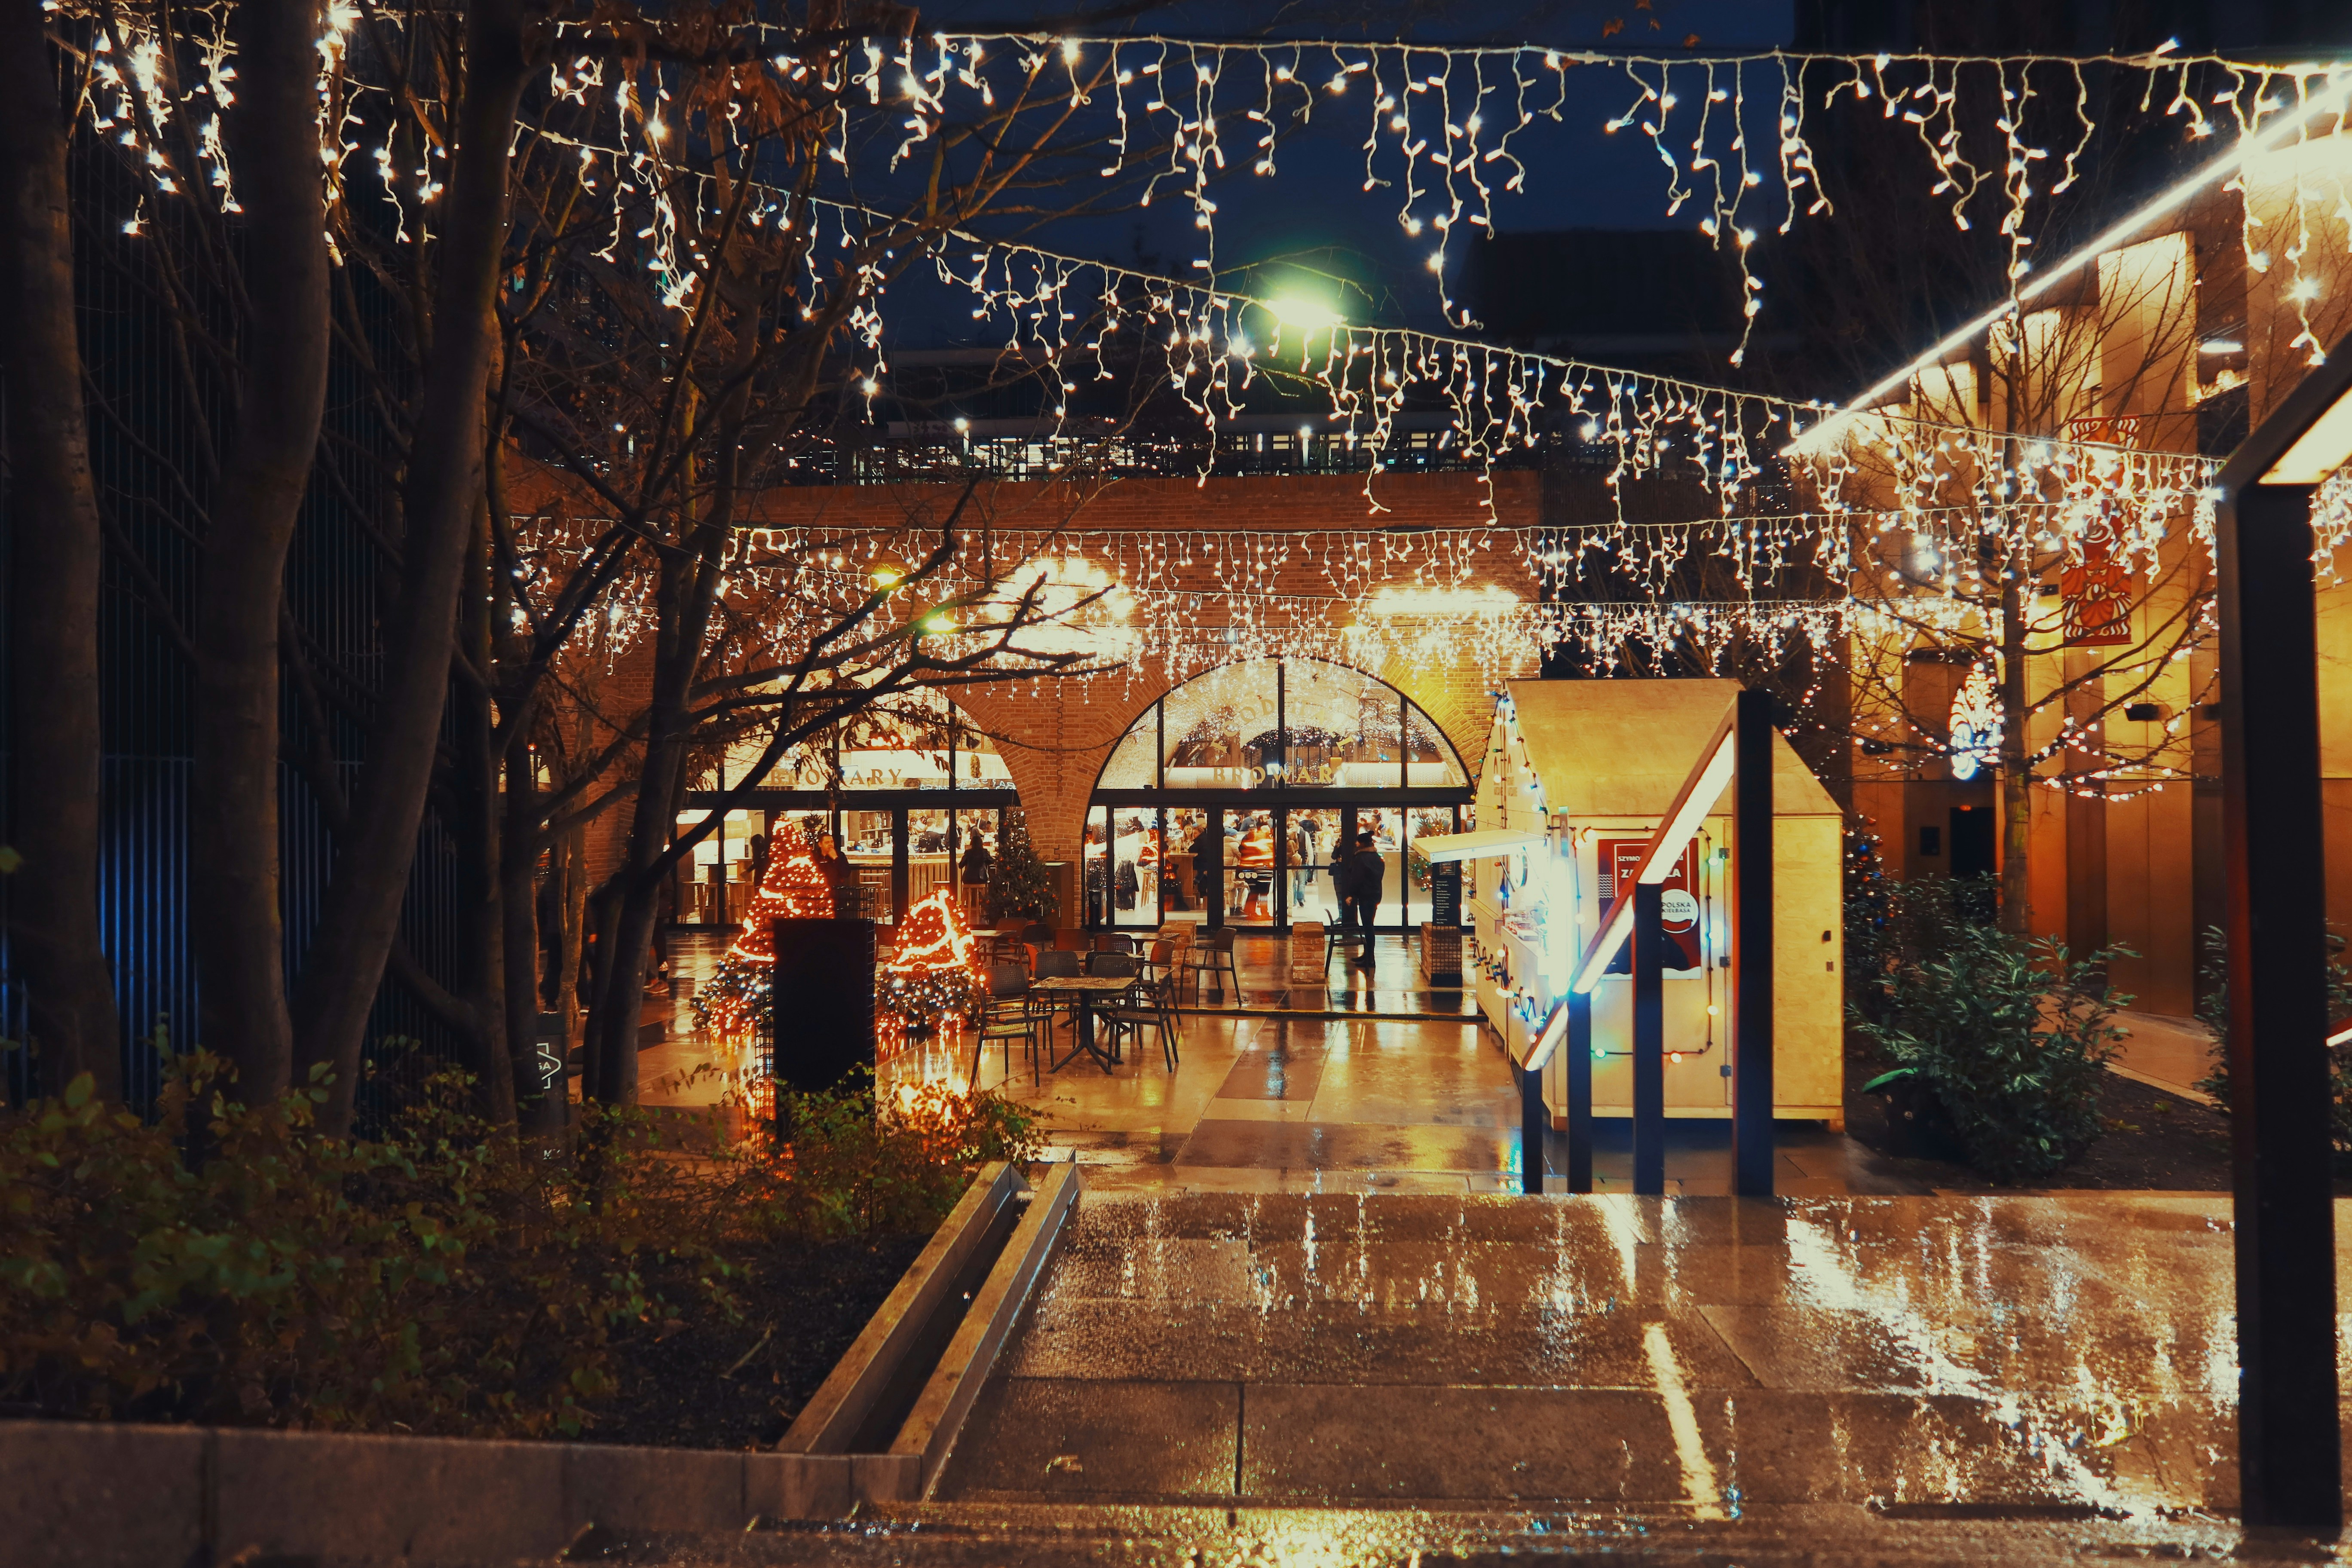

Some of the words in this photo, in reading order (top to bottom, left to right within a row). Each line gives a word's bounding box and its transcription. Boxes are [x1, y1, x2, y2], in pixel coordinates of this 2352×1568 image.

[1210, 699, 1275, 753] FOOD
[1291, 697, 1354, 752] HALL
[771, 768, 902, 785] BROARY
